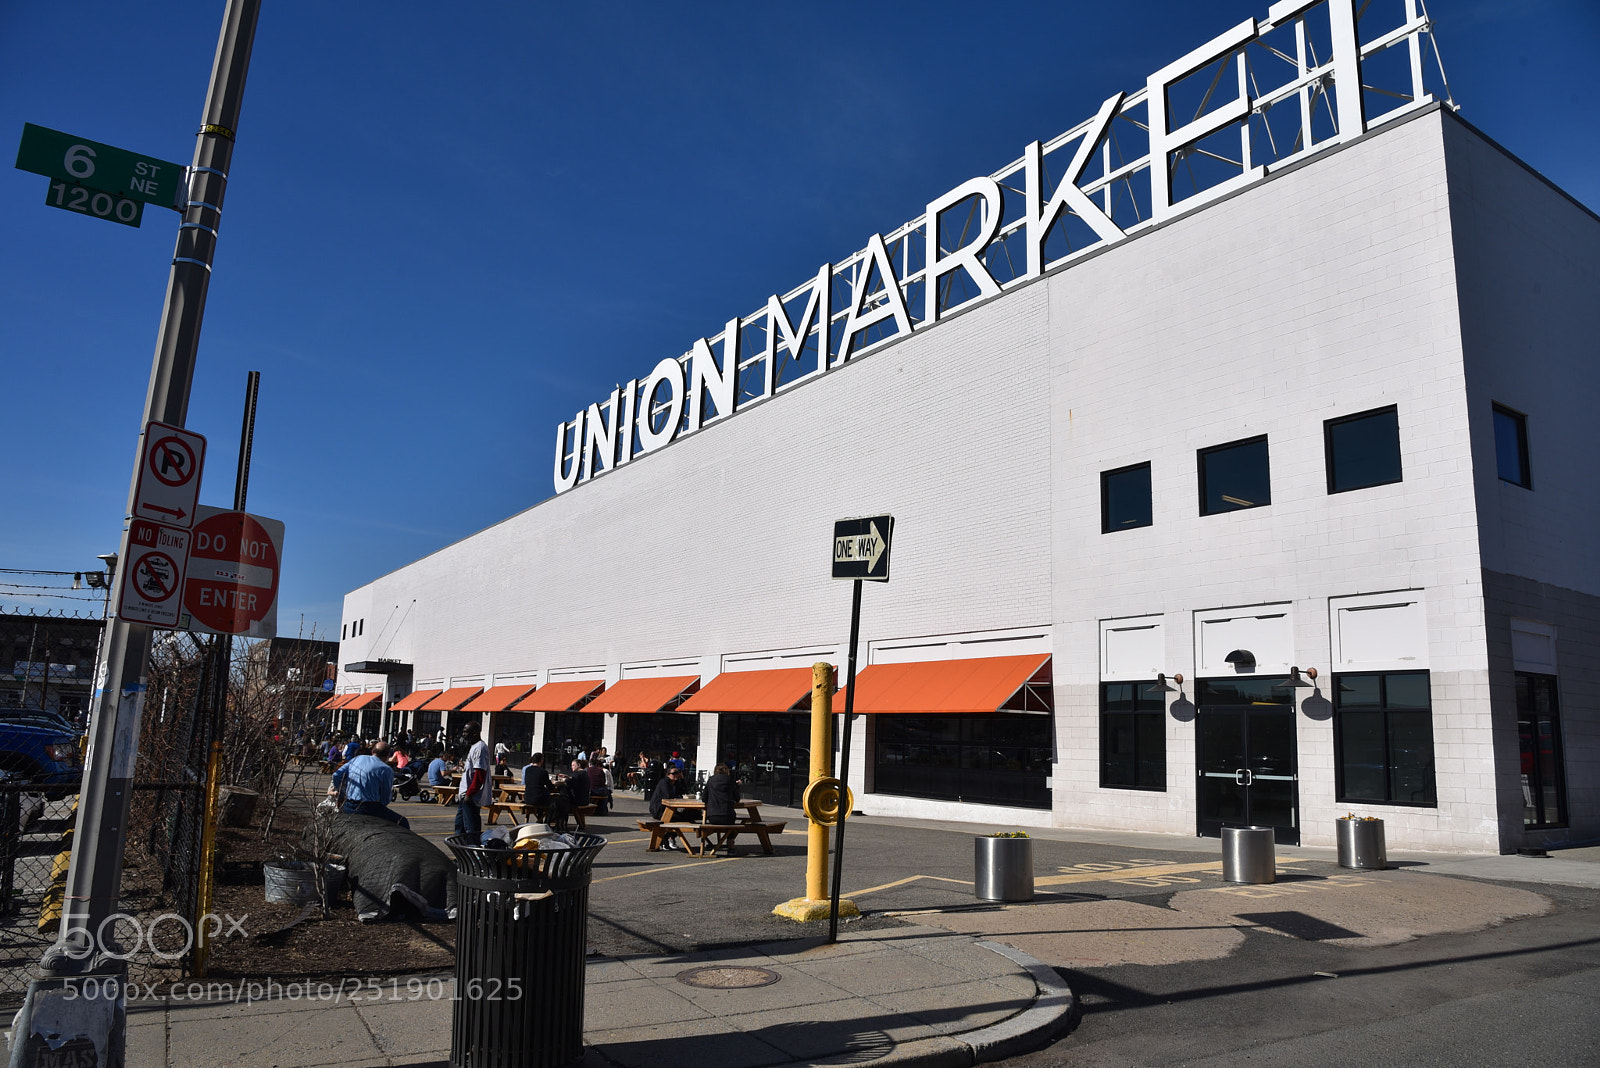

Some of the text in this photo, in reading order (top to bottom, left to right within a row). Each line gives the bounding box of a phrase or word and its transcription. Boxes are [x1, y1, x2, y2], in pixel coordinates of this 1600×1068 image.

[63, 144, 97, 179] 6
[134, 161, 161, 178] ST
[130, 178, 159, 196] NE
[52, 183, 138, 222] 1200
[553, 0, 1364, 495] UNION MARKET
[137, 526, 184, 549] NO IDLING
[197, 531, 268, 560] DO NOT
[836, 537, 878, 558] ONE WAY
[199, 587, 257, 612] ENTER
[1109, 876, 1202, 888] DO
